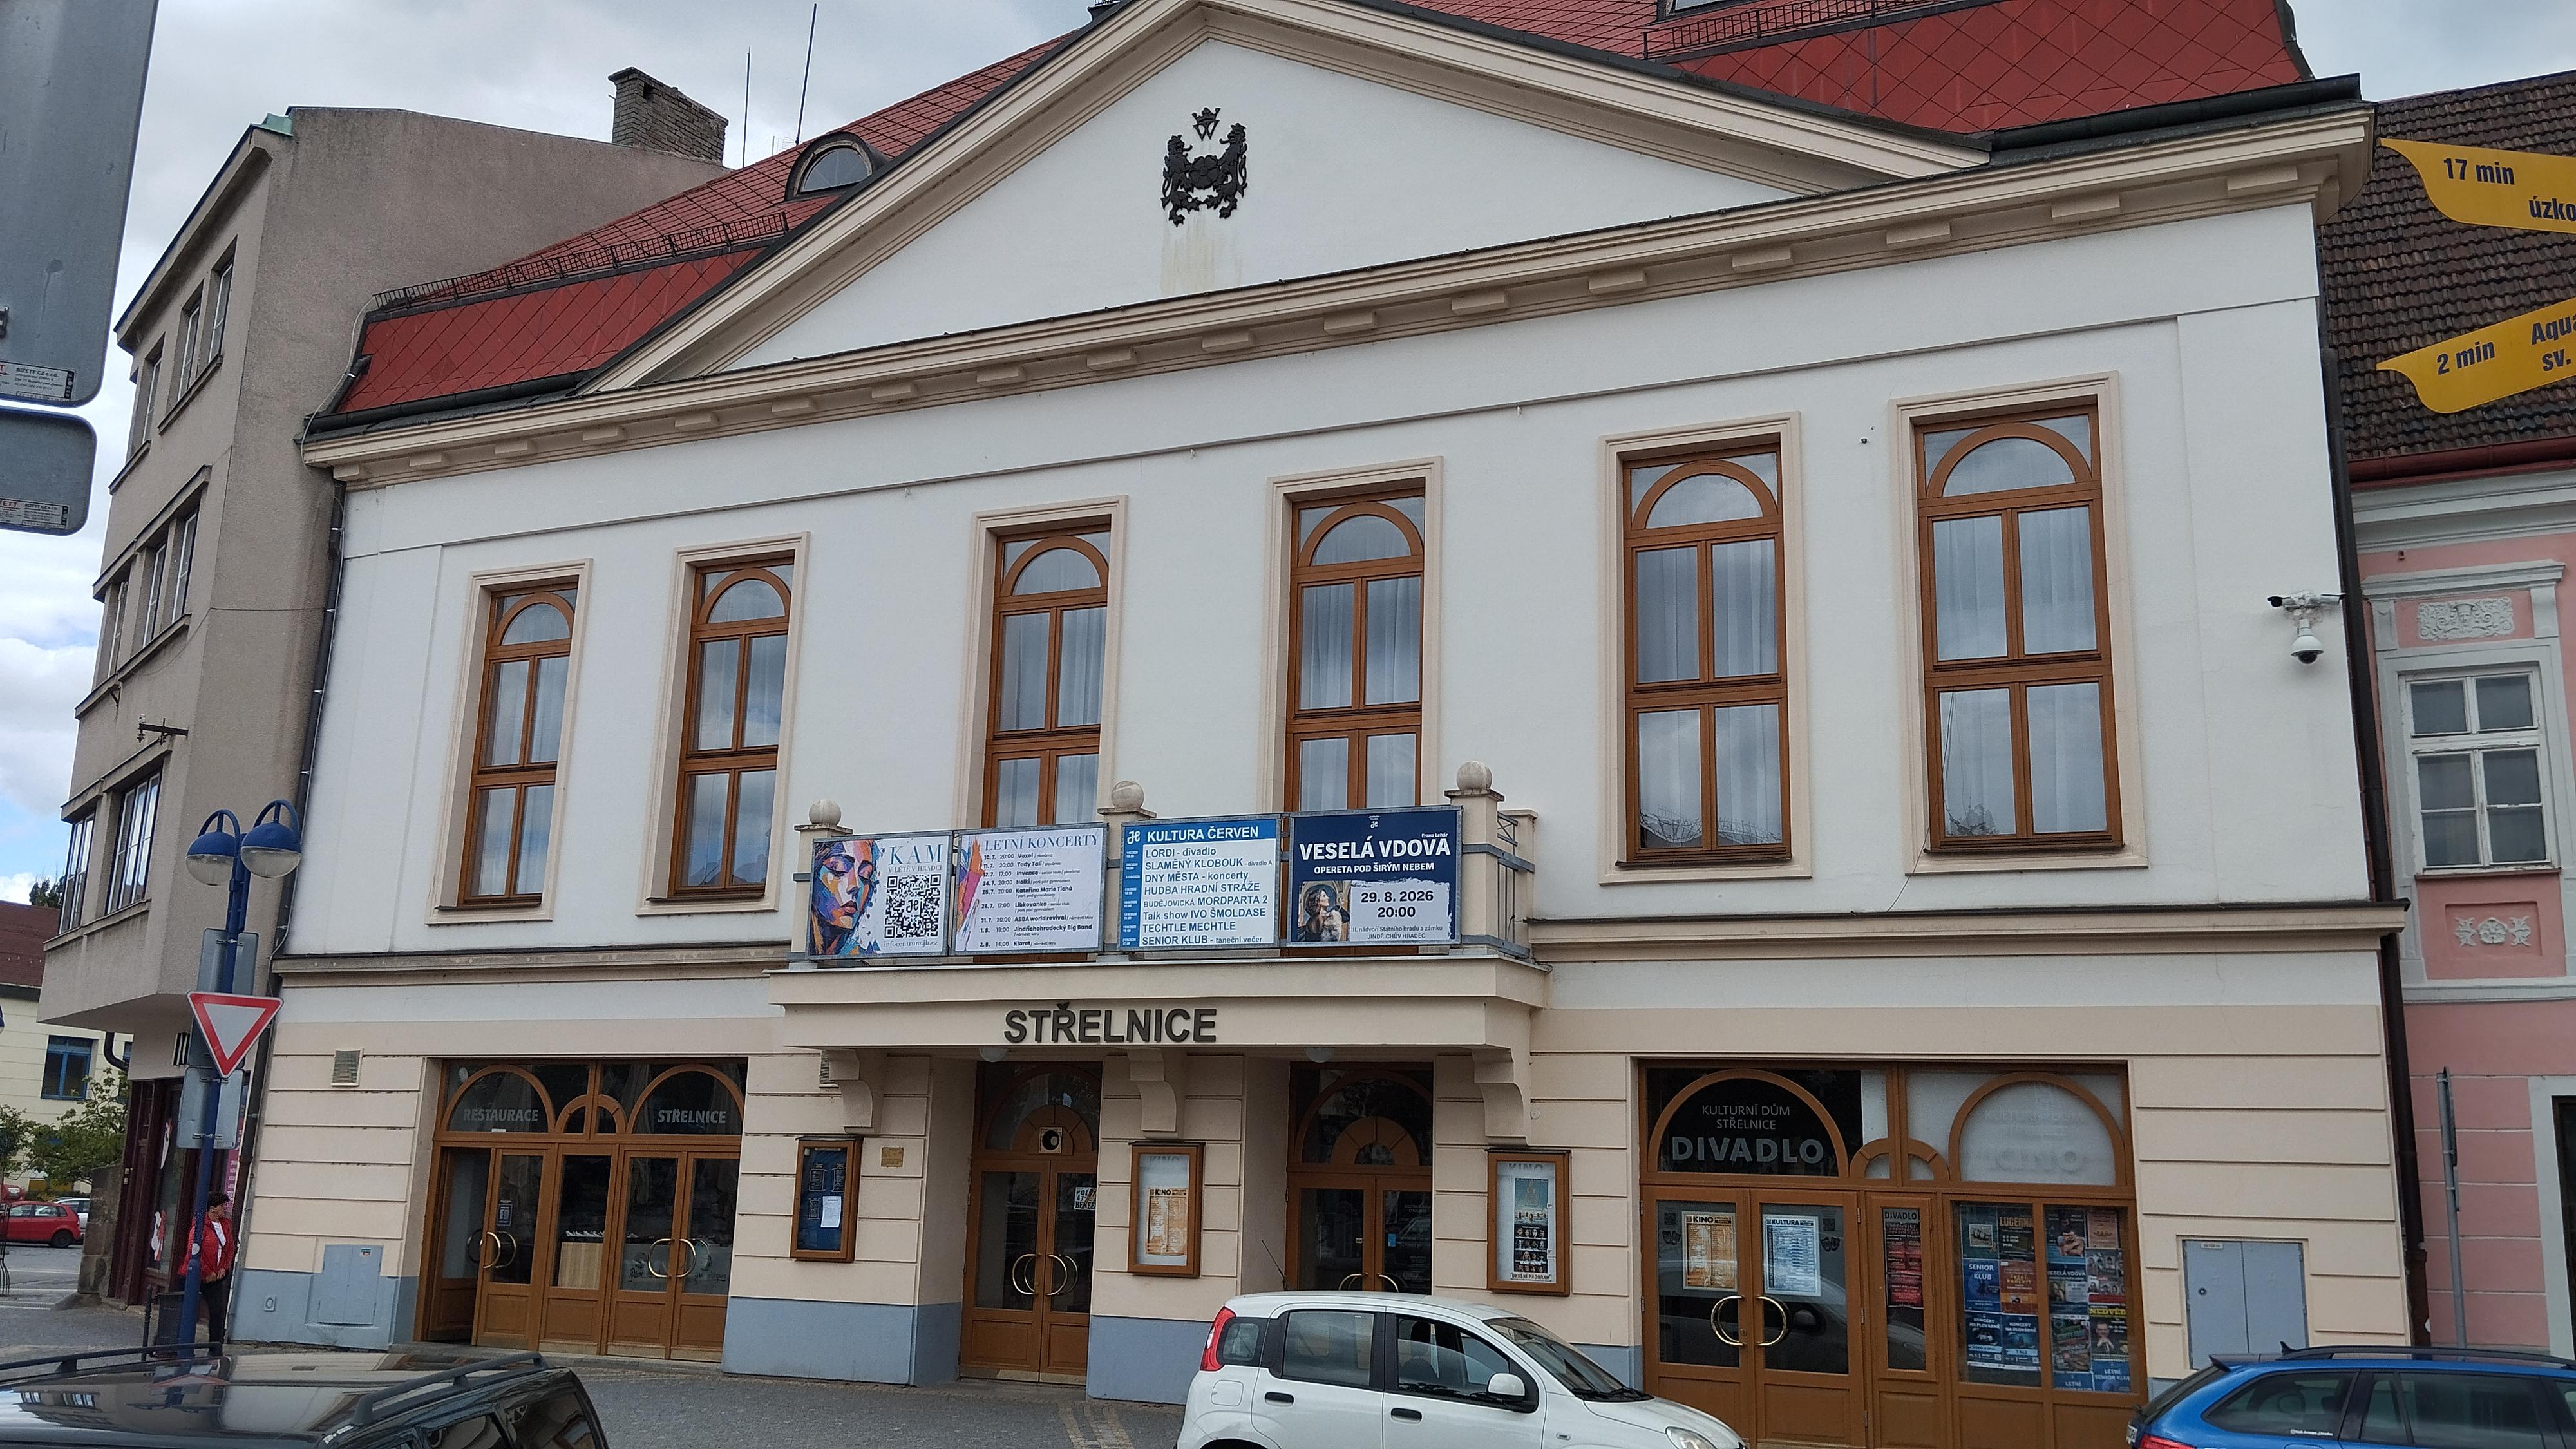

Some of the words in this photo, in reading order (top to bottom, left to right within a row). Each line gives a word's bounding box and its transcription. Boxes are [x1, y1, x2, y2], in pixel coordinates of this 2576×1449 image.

[2443, 158, 2468, 181] 17
[2476, 162, 2515, 185] min
[2528, 195, 2576, 222] úzko
[2437, 354, 2449, 375] 2
[2455, 341, 2496, 370] min
[2542, 348, 2571, 372] sv.
[1147, 829, 1205, 842] KULTURA
[1207, 825, 1258, 839] ČERVEN
[985, 835, 1023, 851] LETNÍ
[1028, 834, 1100, 849] KONCERTY
[1299, 835, 1375, 860] VESELÁ
[1379, 838, 1451, 857] VDOVA
[889, 844, 943, 865] KAM
[1146, 849, 1175, 858] LORDI
[1182, 847, 1217, 857] divadlo
[894, 865, 911, 873] LÉTĚ
[1145, 858, 1191, 870] SLAMĚNÝ
[1194, 858, 1243, 868] KLOBOUK
[1314, 866, 1352, 875] OPERETA
[1354, 864, 1372, 873] POD
[1373, 862, 1401, 873] ŠIRÝM
[1402, 862, 1435, 871] NEBEM
[1145, 873, 1164, 883] DNY
[1167, 871, 1200, 882] MĚSTA
[1208, 871, 1249, 883] koncerty
[1144, 886, 1179, 895] HUDBA
[1180, 882, 1218, 894] HRADNÍ
[1220, 881, 1260, 893] STRÁŽE
[1143, 898, 1195, 908] BUDĚJOVICKÁ
[1197, 895, 1260, 905] MORDPARTA
[1262, 895, 1268, 904] 2
[1361, 891, 1381, 903] 29.
[1384, 891, 1396, 902] 8.
[1399, 890, 1434, 902] 2026
[1143, 911, 1161, 920] Talk
[1163, 911, 1188, 920] show
[1191, 909, 1208, 918] IVO
[1209, 907, 1267, 918] ŠMOLDASE
[1377, 906, 1416, 918] 20:00
[1142, 923, 1186, 933] TECHTLE
[1189, 922, 1236, 932] MECHTLE
[1142, 936, 1179, 945] SENIOR
[1181, 934, 1208, 944] KLUB
[1215, 936, 1242, 944] taneční
[1003, 1001, 1217, 1043] STŘELNICE
[464, 1108, 539, 1121] RESTAURACE
[658, 1108, 726, 1124] STŘELNICE
[1701, 1103, 1759, 1115] KULTURNÍ
[1761, 1103, 1790, 1116] DŮM
[1716, 1117, 1776, 1130] STŘELNICE
[1672, 1136, 1824, 1164] DIVADLO
[1884, 1211, 1917, 1220] DIVADLO
